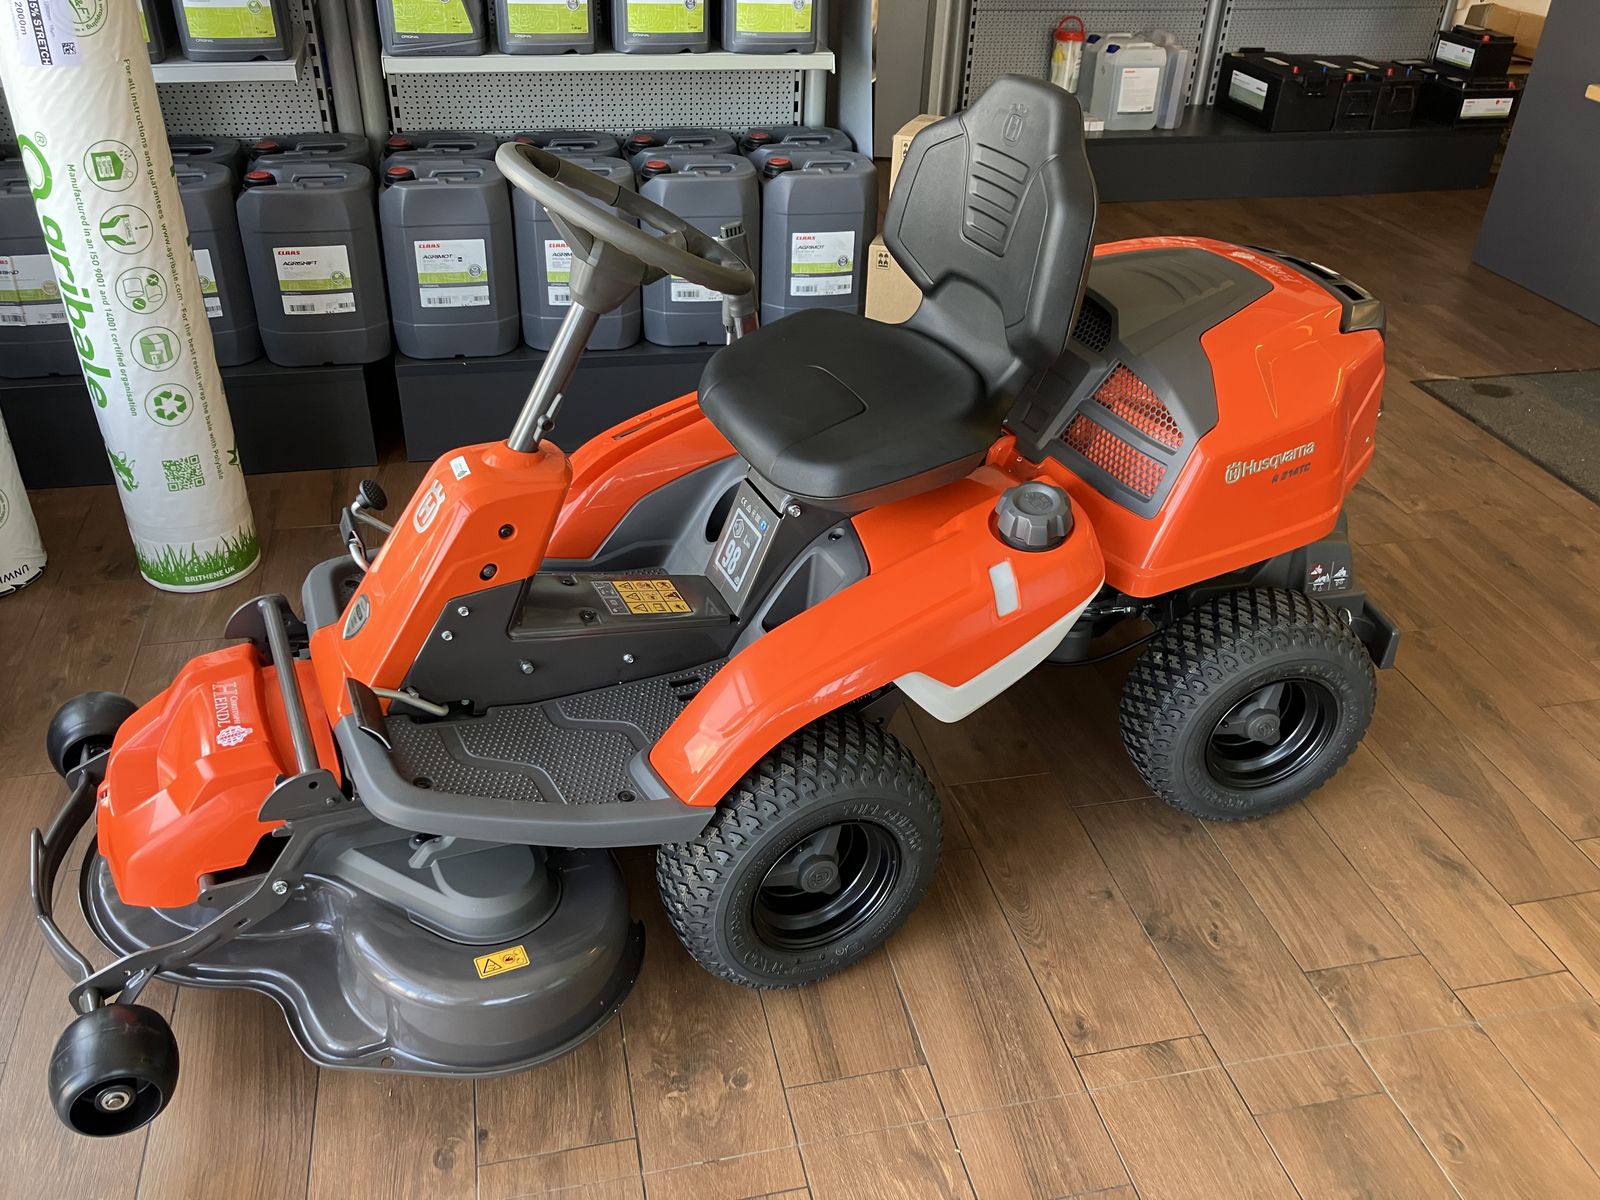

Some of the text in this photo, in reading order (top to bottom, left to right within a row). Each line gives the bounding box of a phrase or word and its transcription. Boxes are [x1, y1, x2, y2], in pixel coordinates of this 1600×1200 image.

[33, 19, 53, 66] STRETCH
[123, 58, 132, 75] For
[128, 78, 136, 90] all
[131, 92, 148, 148] instructions
[144, 151, 153, 167] and
[147, 169, 164, 220] guarantees
[161, 223, 184, 301] www.agribale.com
[67, 163, 138, 417] Manufactured in an ISO 9001 and 14001 certified organisation
[192, 357, 202, 381] result
[198, 381, 206, 400] wrap
[201, 401, 209, 415] the
[209, 432, 217, 449] with
[213, 450, 224, 480] Polybale
[1241, 441, 1315, 478] Husqvarna
[721, 539, 742, 576] 98
[184, 565, 235, 583] BRITHENE UK
